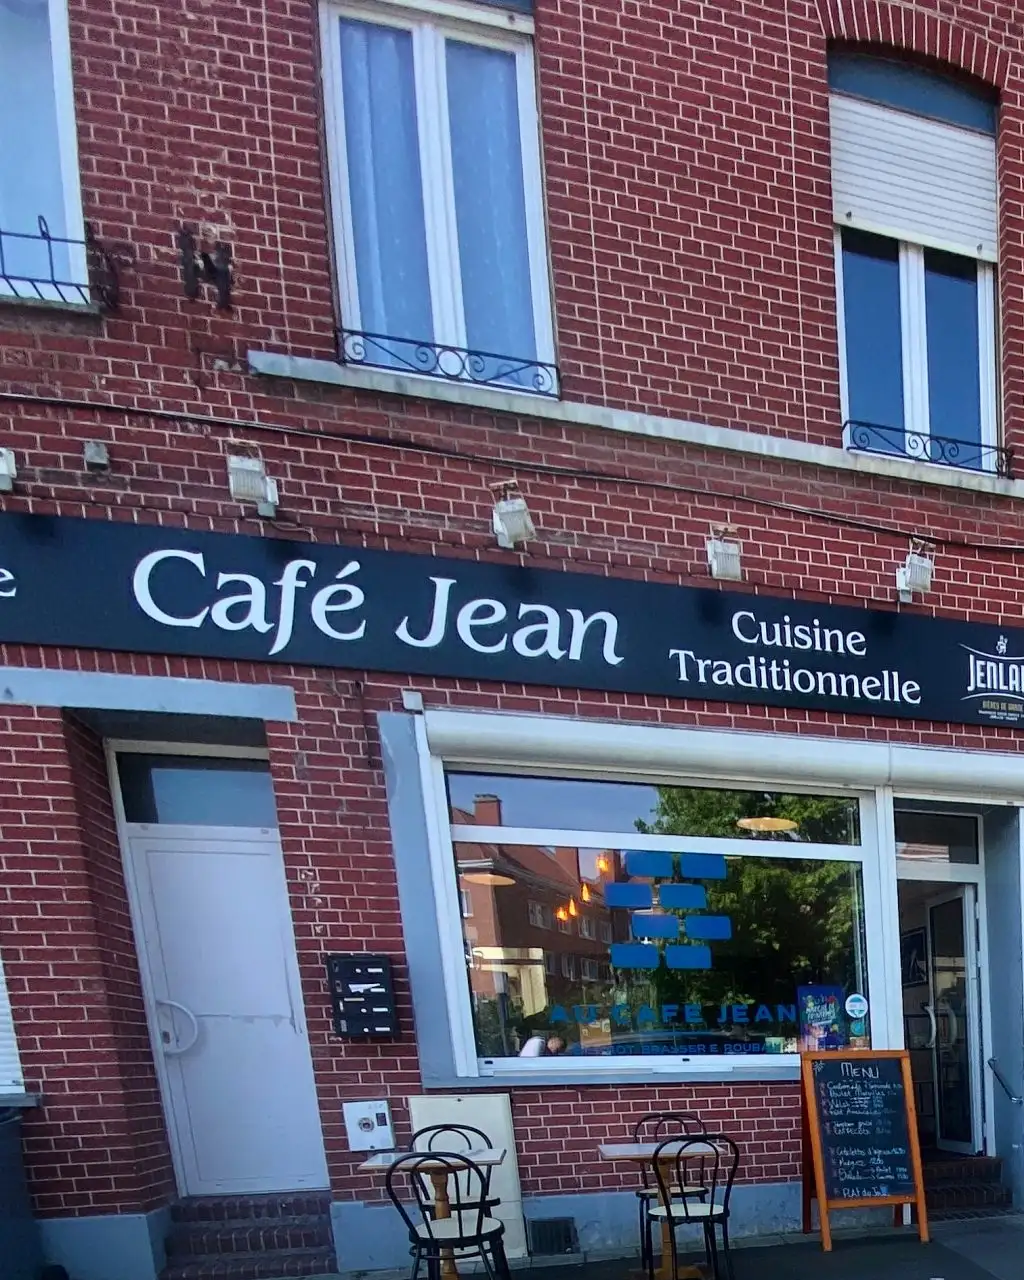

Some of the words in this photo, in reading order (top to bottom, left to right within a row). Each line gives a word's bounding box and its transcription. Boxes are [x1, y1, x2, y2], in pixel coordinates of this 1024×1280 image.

[133, 549, 366, 655] Café
[395, 576, 625, 666] Jean
[731, 610, 867, 656] Cuisine
[668, 649, 922, 704] Traditionnelle
[550, 1004, 600, 1023] AU
[716, 1003, 797, 1024] JEAN
[841, 1062, 879, 1078] MENU
